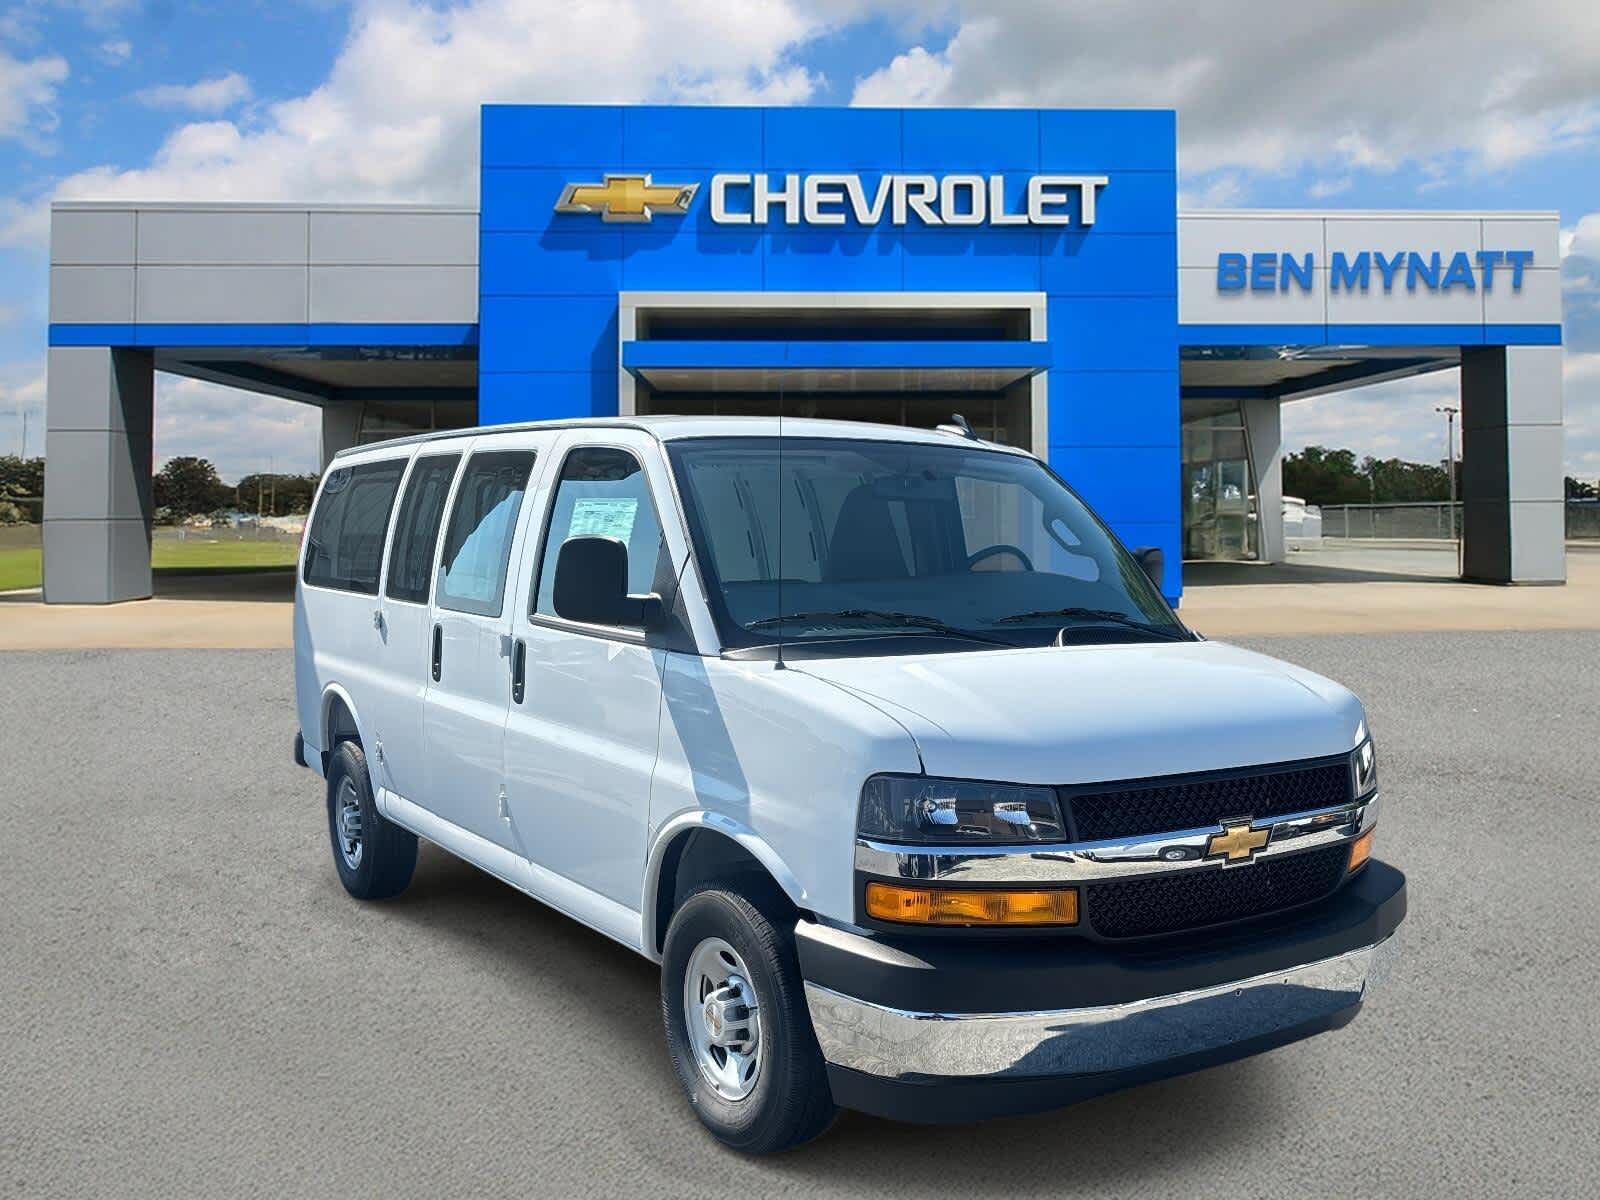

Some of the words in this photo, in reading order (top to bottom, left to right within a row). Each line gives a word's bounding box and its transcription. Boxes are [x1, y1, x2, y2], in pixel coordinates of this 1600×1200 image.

[710, 173, 1109, 225] CHEVROLET
[1217, 252, 1314, 291] BEN
[1330, 250, 1534, 291] MYNATT
